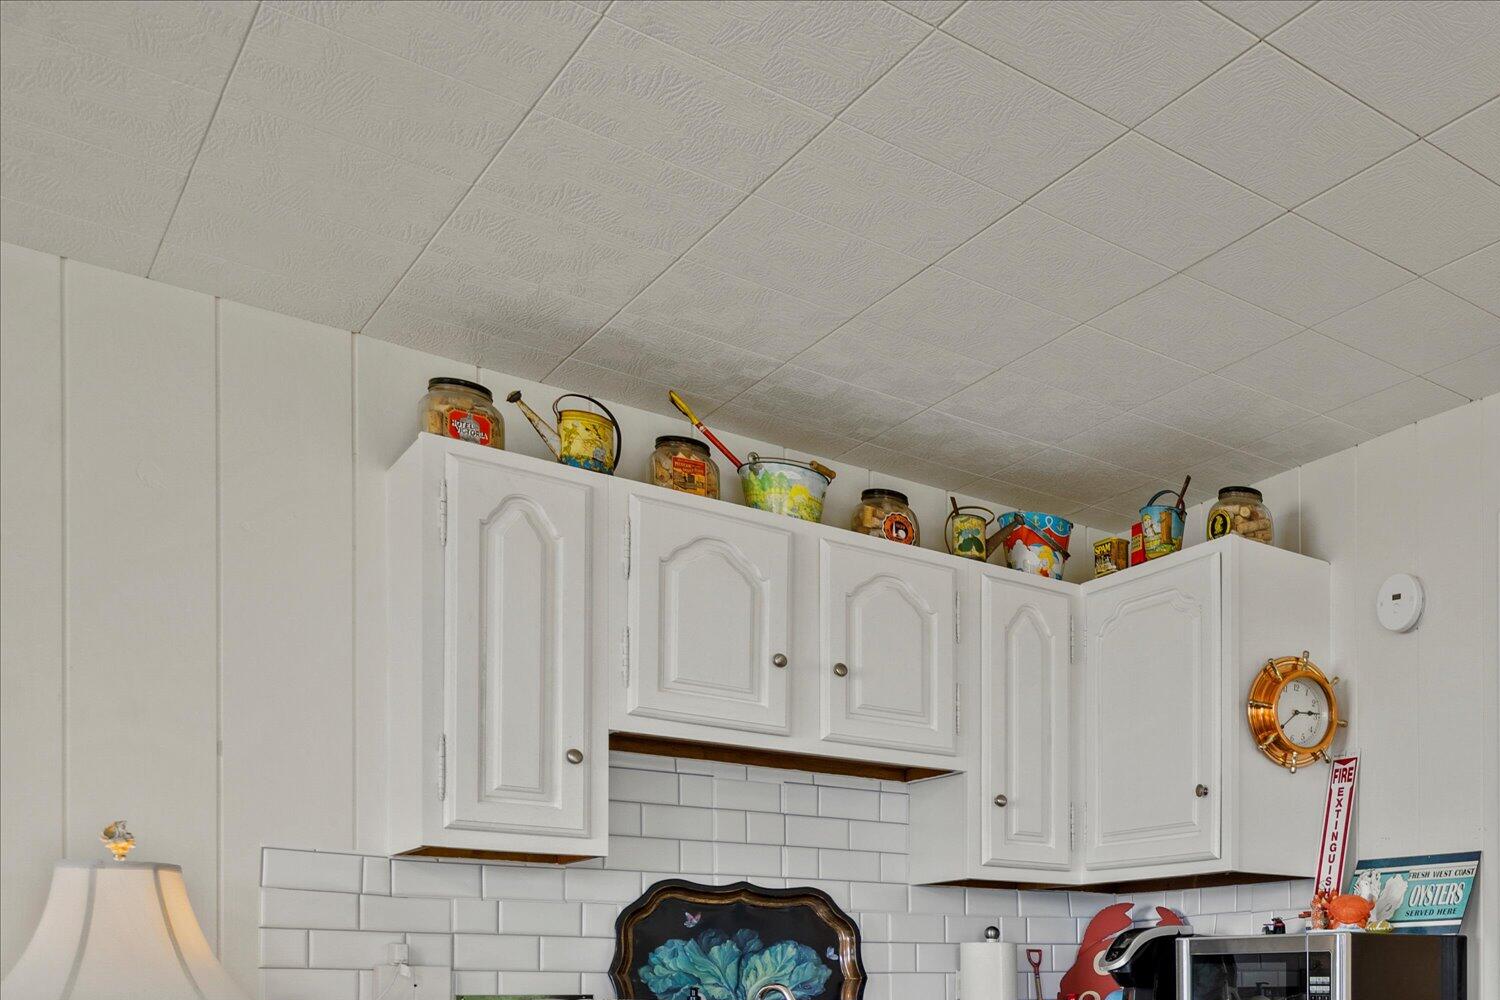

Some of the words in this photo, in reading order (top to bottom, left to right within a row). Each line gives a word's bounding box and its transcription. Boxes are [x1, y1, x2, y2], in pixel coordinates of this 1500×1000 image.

[1332, 767, 1354, 784] FIRE
[1409, 870, 1430, 879] FRESH
[1433, 868, 1452, 878] WEST
[1455, 867, 1476, 876] COAST
[1409, 882, 1466, 907] OYSTERS
[1405, 909, 1434, 917] SERVED
[1437, 907, 1457, 915] HERE
